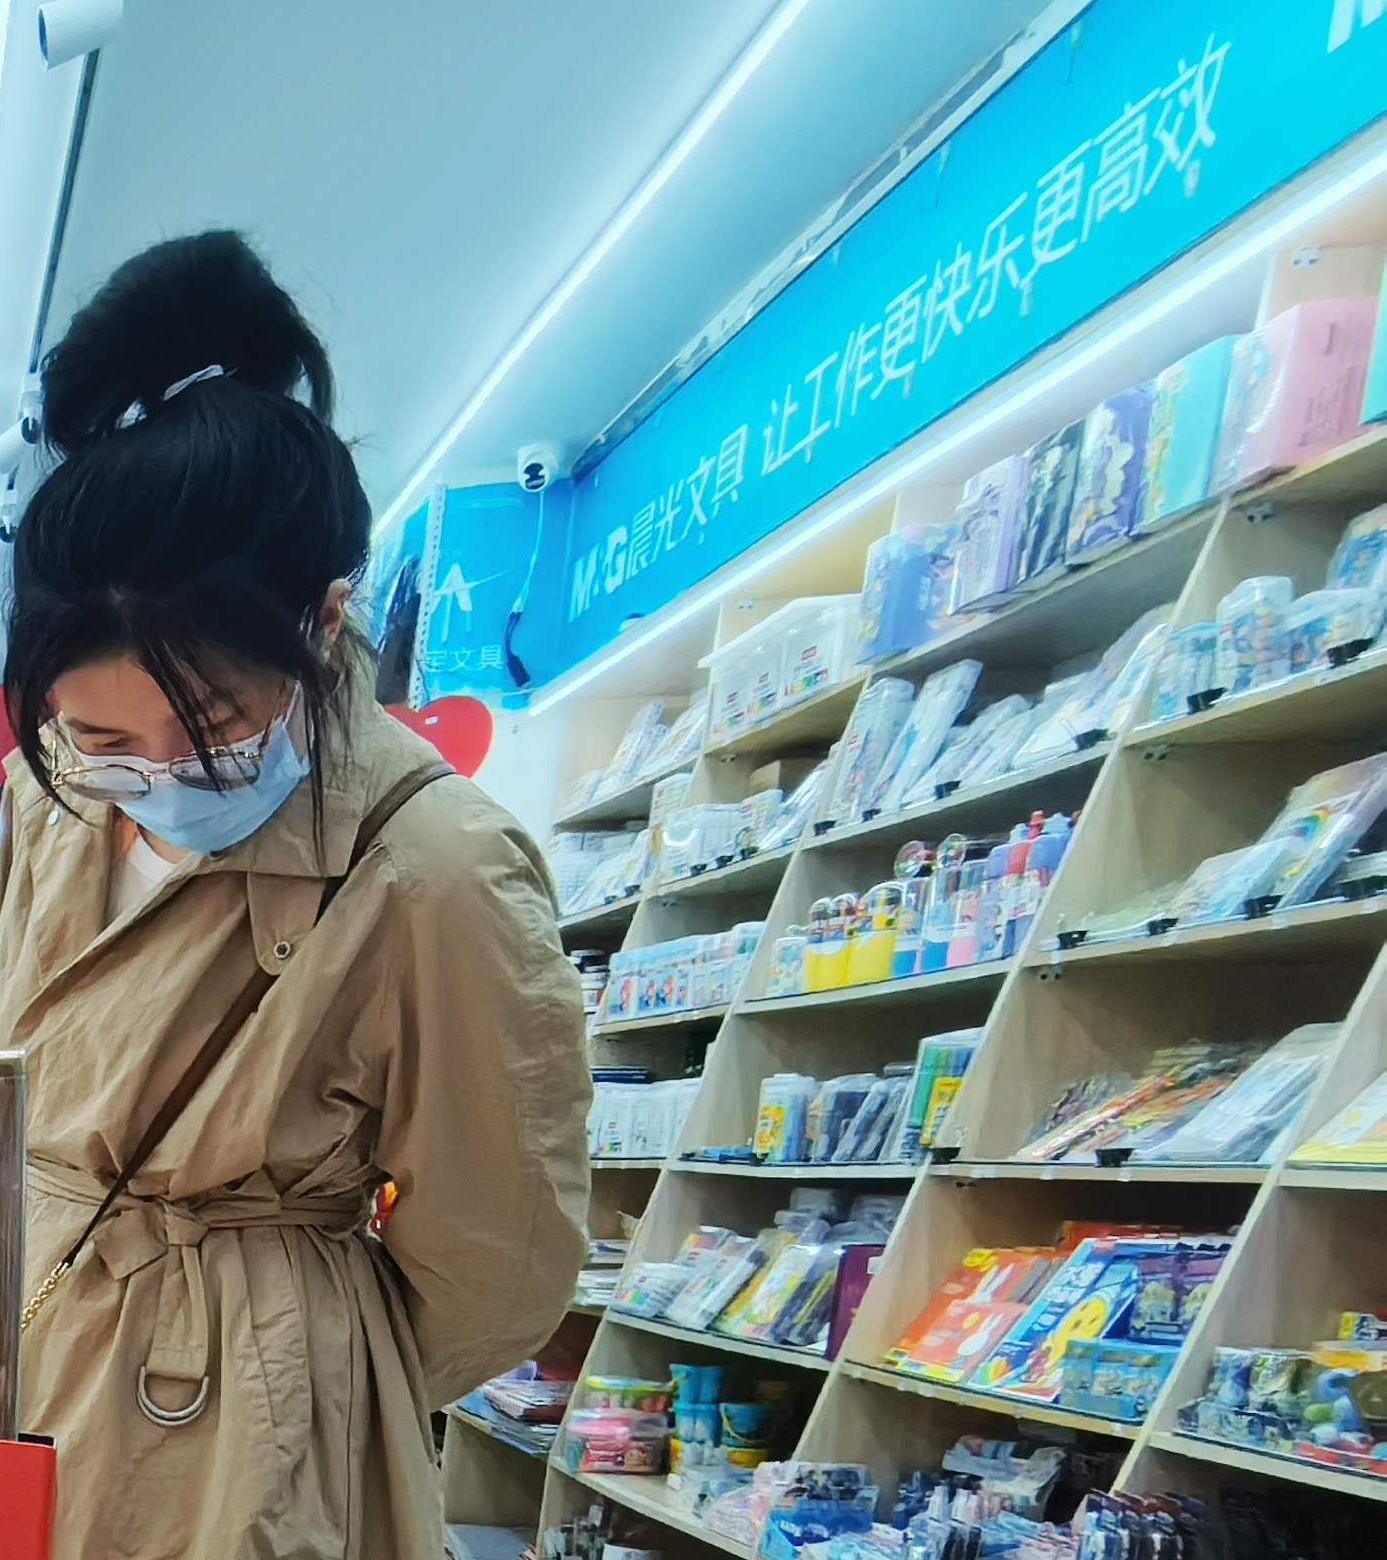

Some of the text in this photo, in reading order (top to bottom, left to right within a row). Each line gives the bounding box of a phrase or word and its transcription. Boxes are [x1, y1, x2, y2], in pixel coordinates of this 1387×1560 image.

[763, 32, 1230, 476] 让工作更快乐更高效
